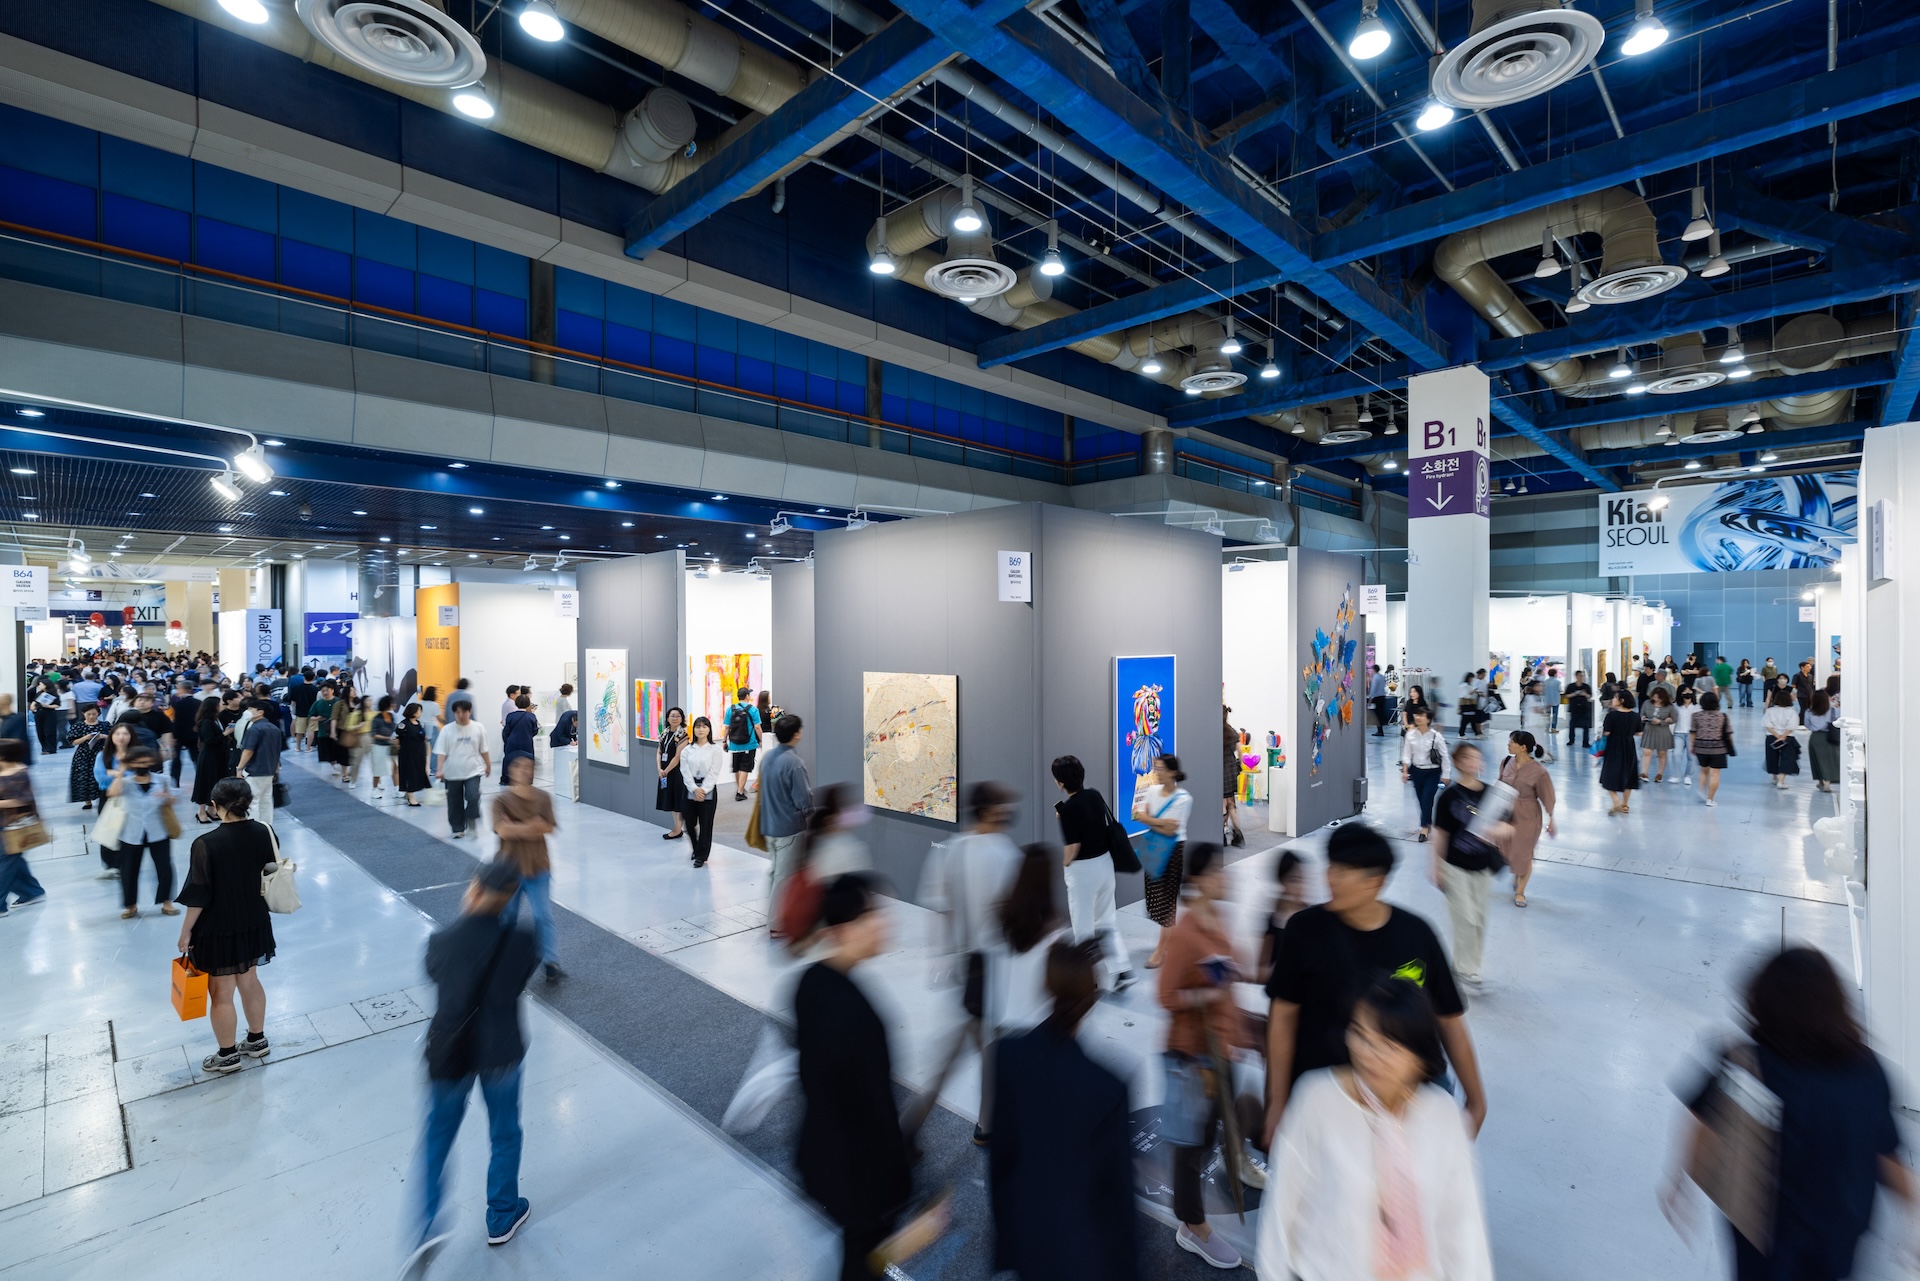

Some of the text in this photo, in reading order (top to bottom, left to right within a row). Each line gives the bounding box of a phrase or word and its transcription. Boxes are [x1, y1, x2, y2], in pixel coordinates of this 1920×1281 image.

[1424, 420, 1456, 450] B1
[1420, 457, 1460, 474] 소화전
[1435, 472, 1455, 480] hydrant
[1606, 525, 1670, 548] SEOUL
[1009, 556, 1022, 567] B69
[13, 569, 33, 578] B64
[258, 614, 273, 663] Kiaf SEOUL
